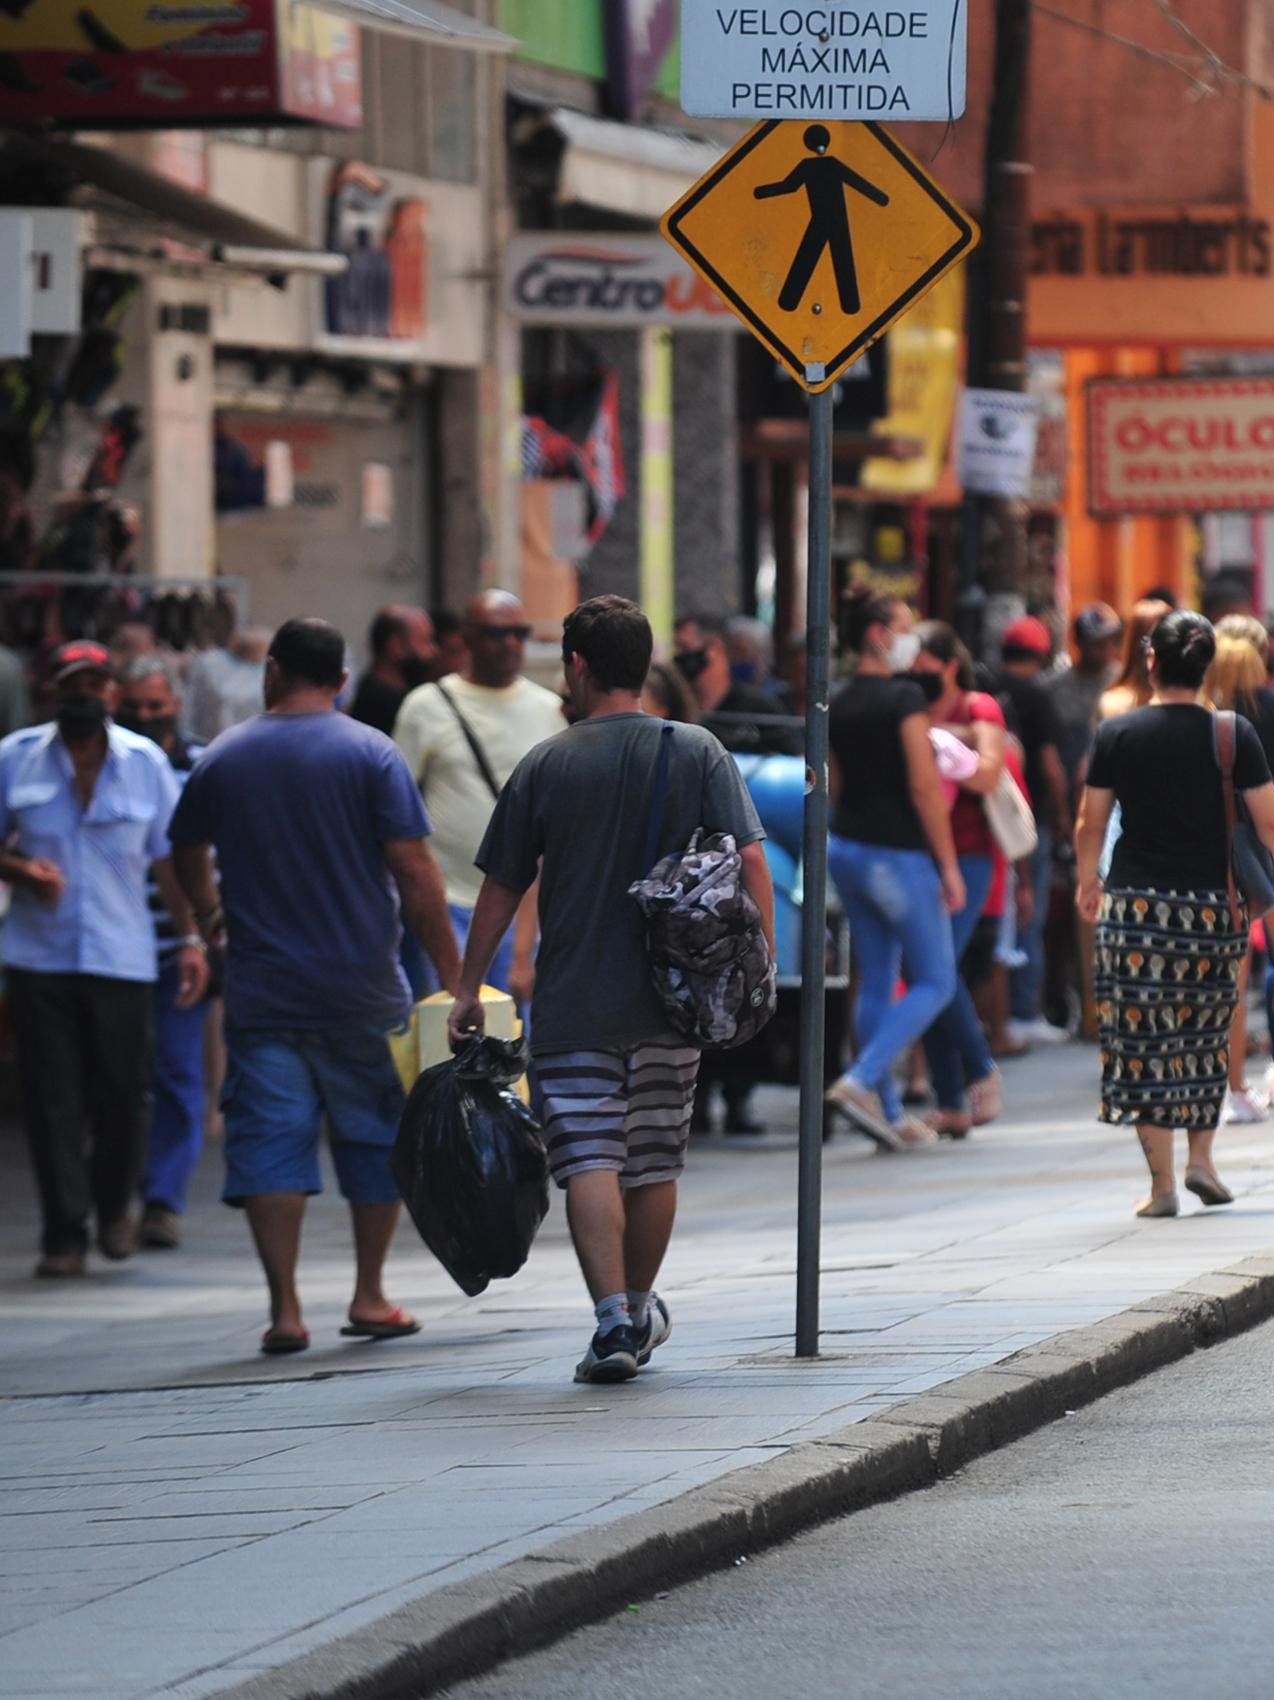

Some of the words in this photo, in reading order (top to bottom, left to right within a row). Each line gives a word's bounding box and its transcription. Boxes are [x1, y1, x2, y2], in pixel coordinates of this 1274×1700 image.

[716, 9, 928, 38] VELOCIDADE
[761, 42, 890, 73] MÁXIMA
[732, 83, 910, 111] PERMITIDA
